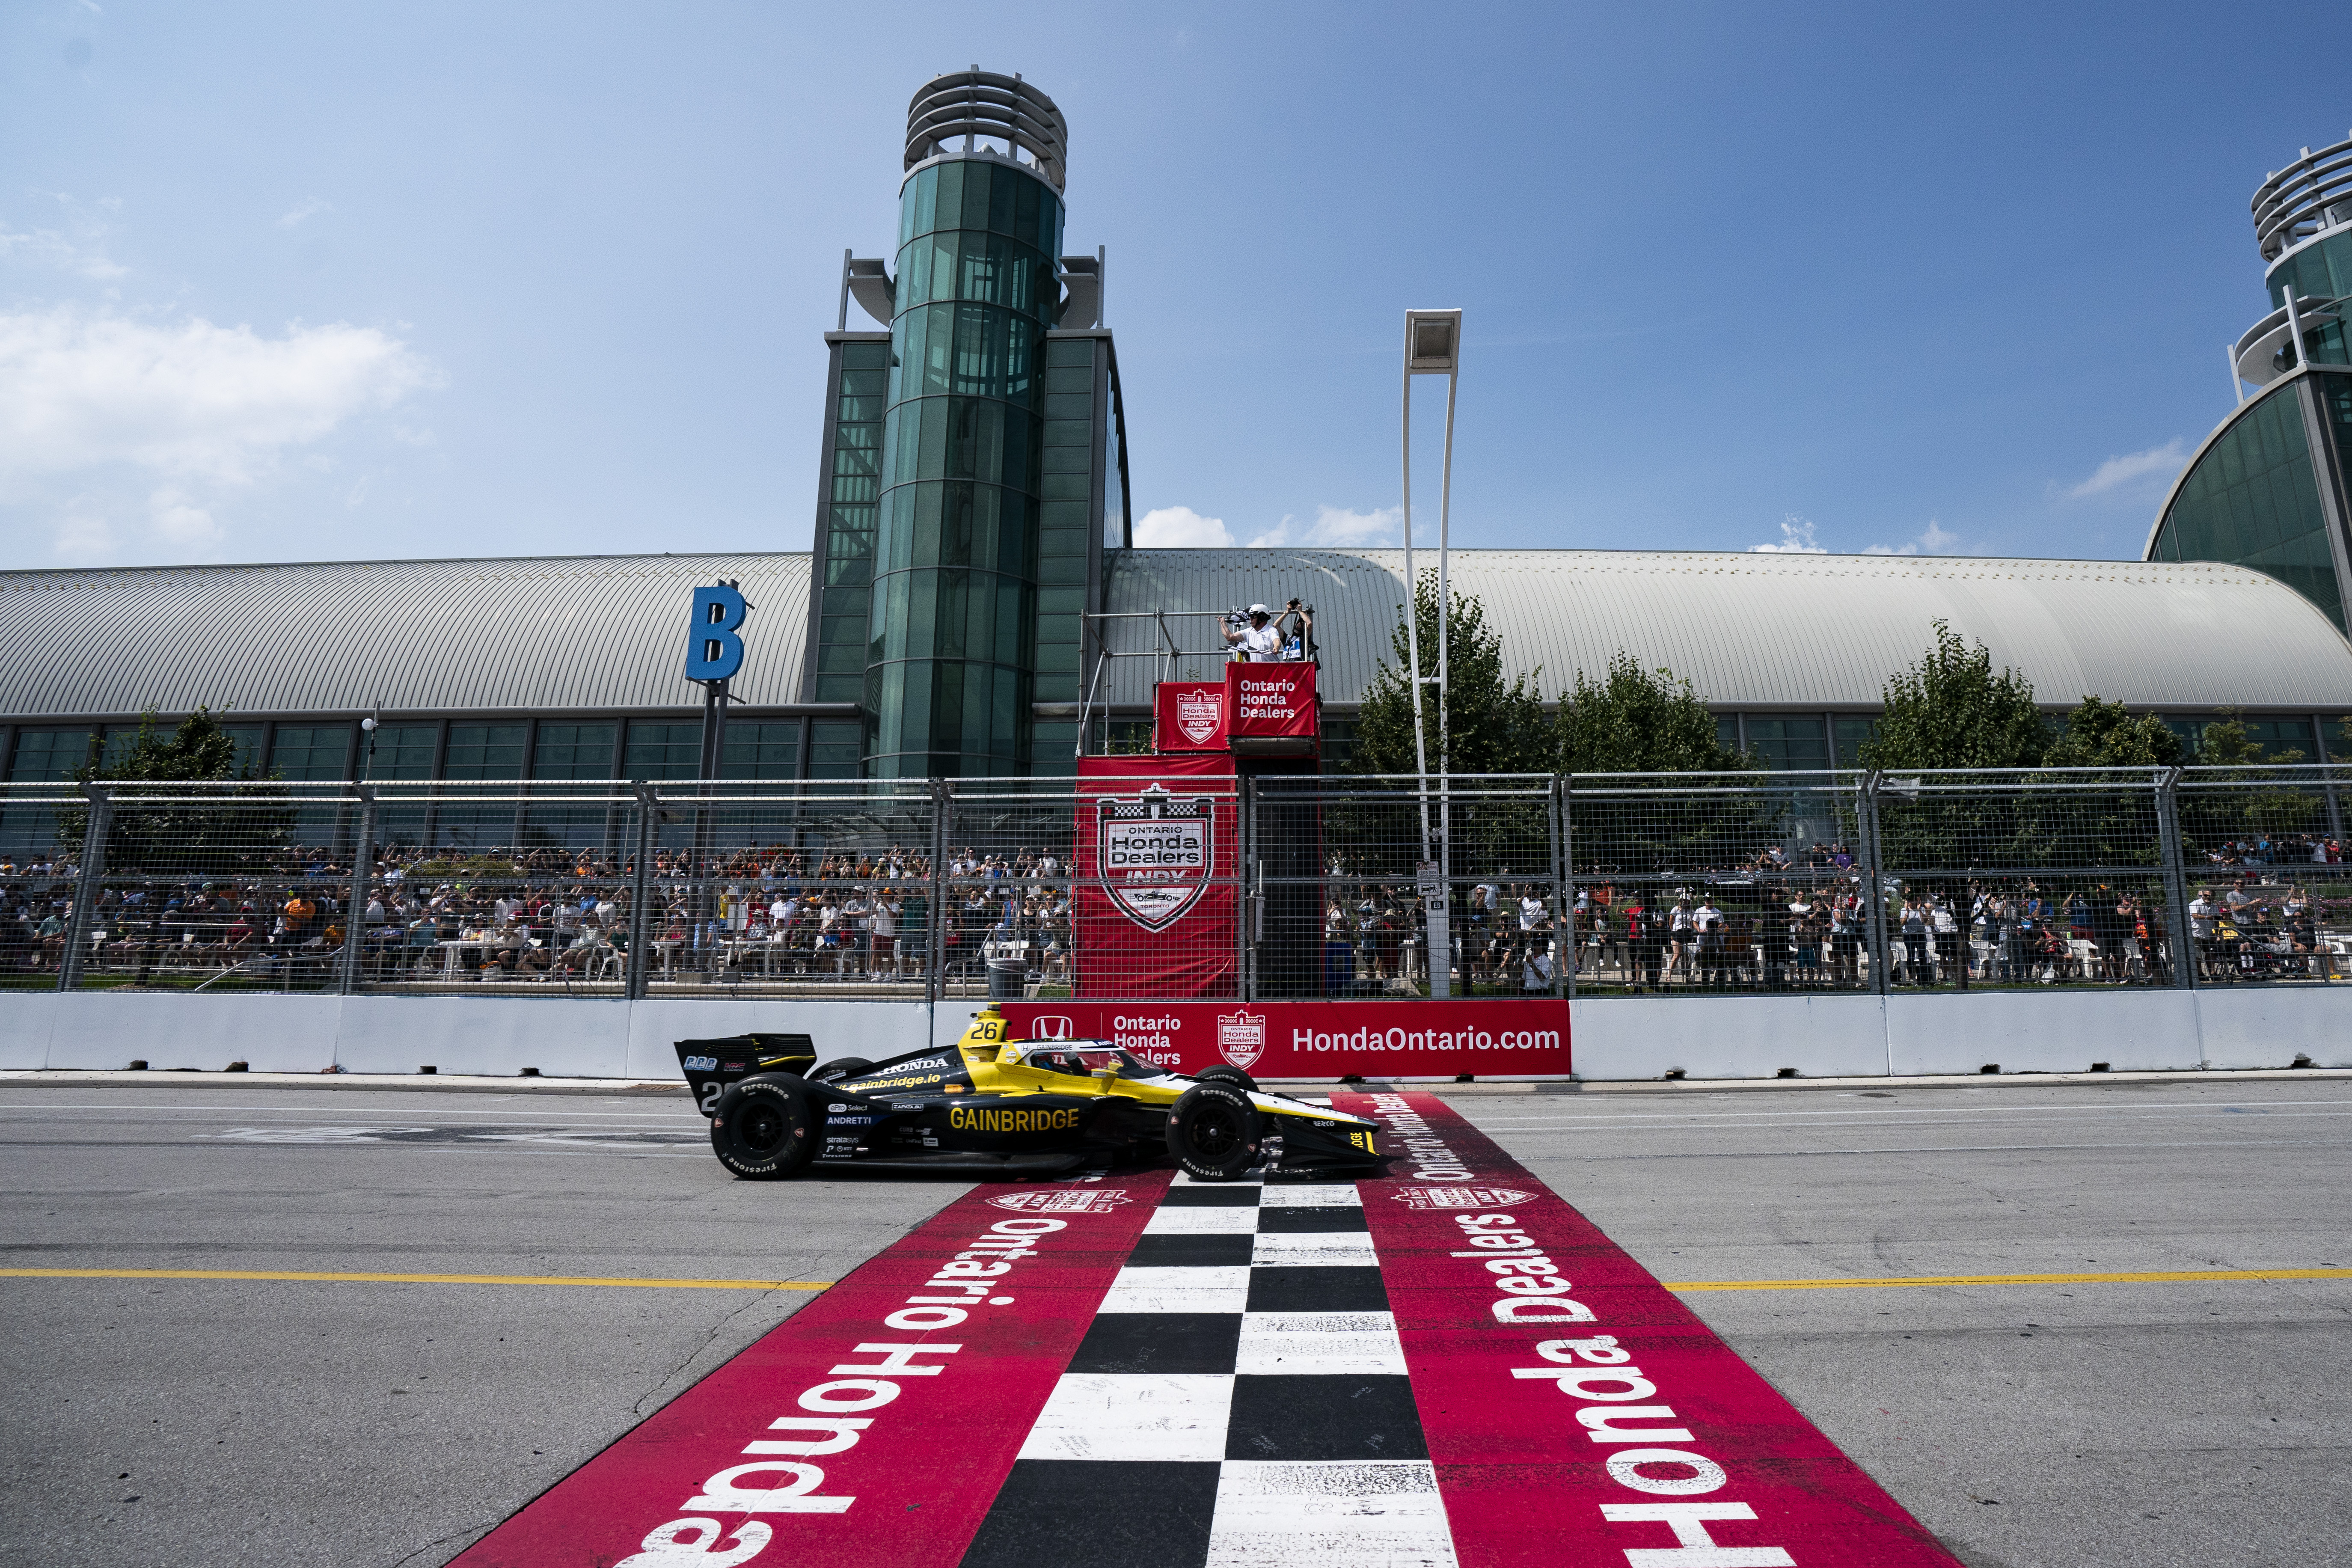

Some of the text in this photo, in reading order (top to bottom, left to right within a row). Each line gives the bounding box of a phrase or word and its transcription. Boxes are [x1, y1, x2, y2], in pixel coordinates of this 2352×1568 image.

[685, 587, 746, 681] B
[1241, 679, 1295, 692] Ontario
[1241, 692, 1286, 705] Honda
[1240, 706, 1295, 718] Dealers
[1128, 826, 1183, 834] ONTARIO
[1112, 835, 1199, 850] Honda
[1112, 850, 1199, 864] Dealers
[1125, 870, 1188, 885] INDY
[1114, 1014, 1181, 1030] Ontario
[971, 1022, 998, 1040] 26
[1114, 1031, 1171, 1048] Honda
[1293, 1025, 1560, 1051] HondaOntario.com
[879, 1058, 949, 1075] HONDA
[740, 1083, 790, 1099] Firestone
[847, 1074, 941, 1093] gainbridge.io
[1200, 1090, 1244, 1107] Firestone
[950, 1108, 1079, 1132] GAINBRIDGE
[1363, 1094, 1475, 1181] Ontario Honda Dealers
[728, 1157, 777, 1173] Firestone
[1182, 1157, 1224, 1176] Firestone
[884, 1219, 1068, 1330] Ontario
[1449, 1214, 1798, 1568] Honda Dealers
